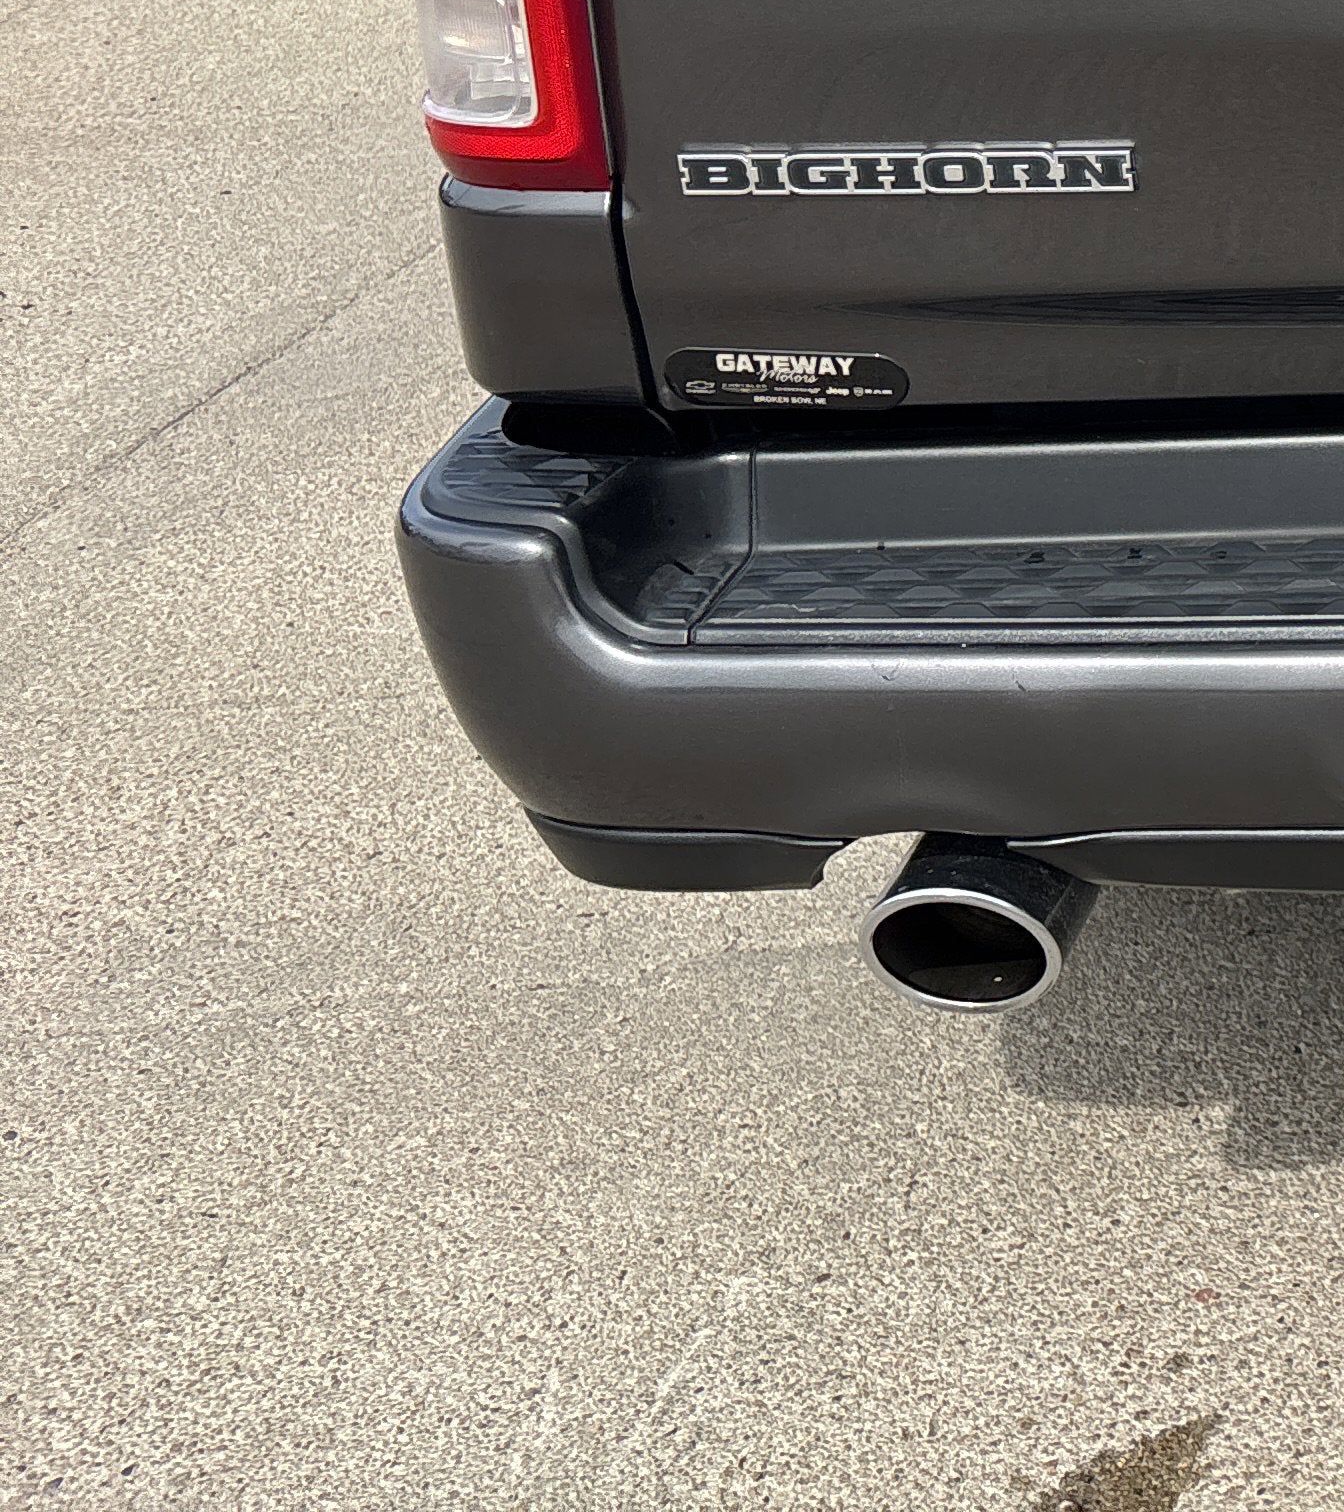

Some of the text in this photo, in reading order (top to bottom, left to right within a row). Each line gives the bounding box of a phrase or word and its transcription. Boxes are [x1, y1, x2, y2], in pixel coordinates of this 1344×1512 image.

[676, 148, 1136, 196] BIGHORN
[715, 353, 855, 376] GATEWAY
[758, 369, 819, 384] Motors
